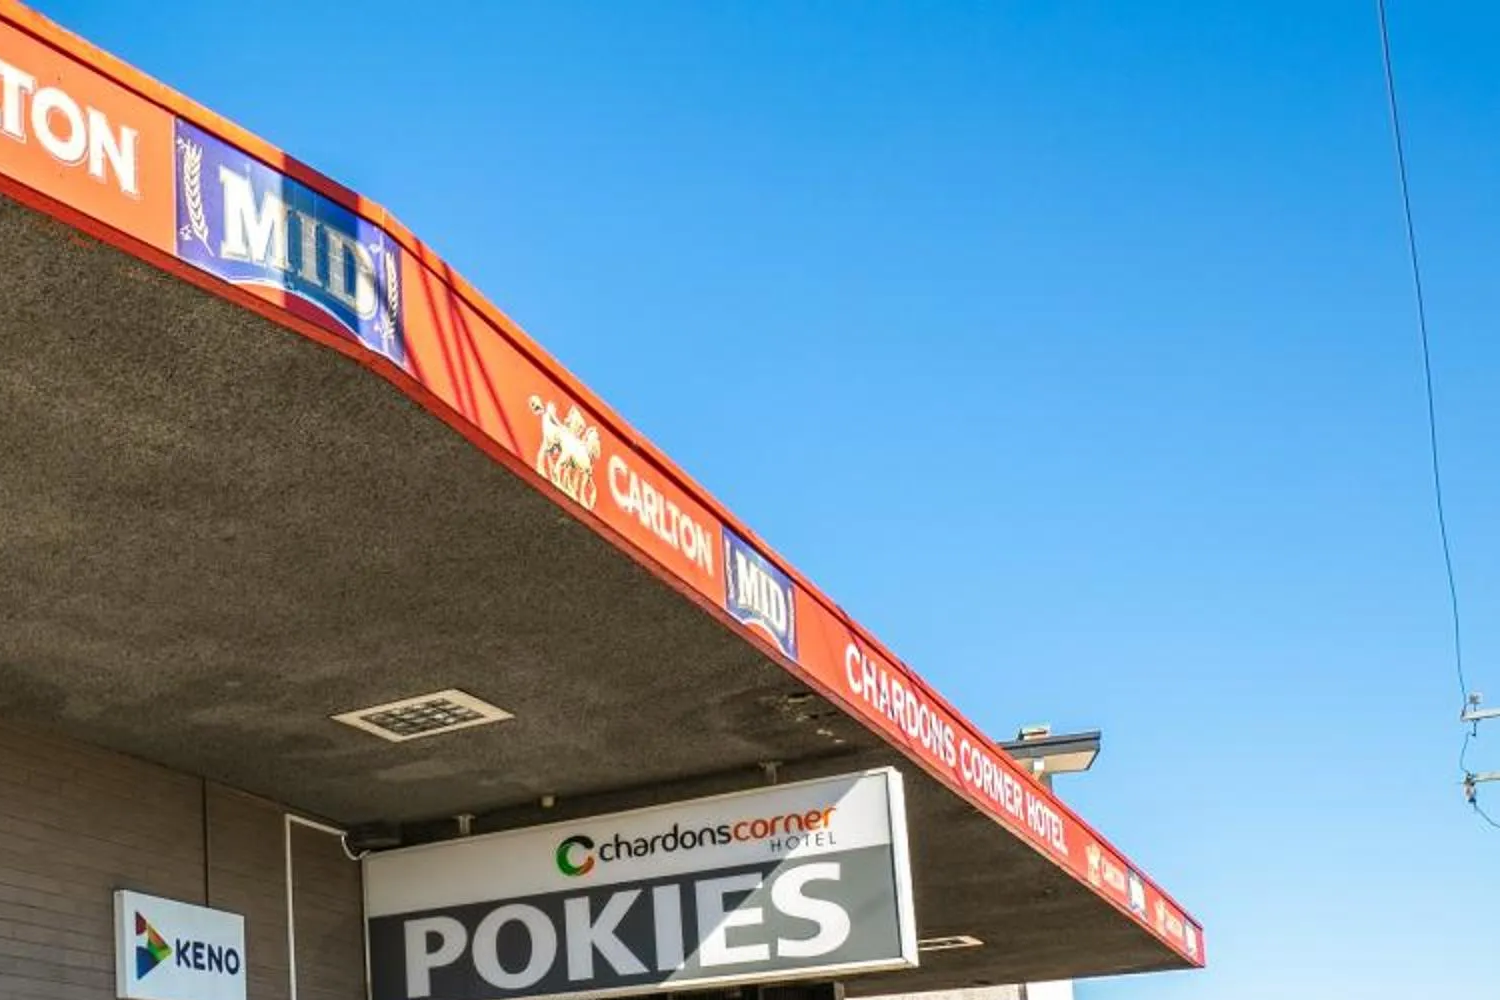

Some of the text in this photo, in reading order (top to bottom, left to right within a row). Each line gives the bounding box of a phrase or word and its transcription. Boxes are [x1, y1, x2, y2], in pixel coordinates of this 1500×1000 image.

[219, 164, 378, 321] MID
[607, 454, 788, 637] CARLTON MID
[845, 643, 1069, 857] CHARDONS CORNER HOTEL
[769, 831, 837, 853] HOTEL
[175, 938, 241, 975] KENO
[403, 862, 851, 1000] POKIES
